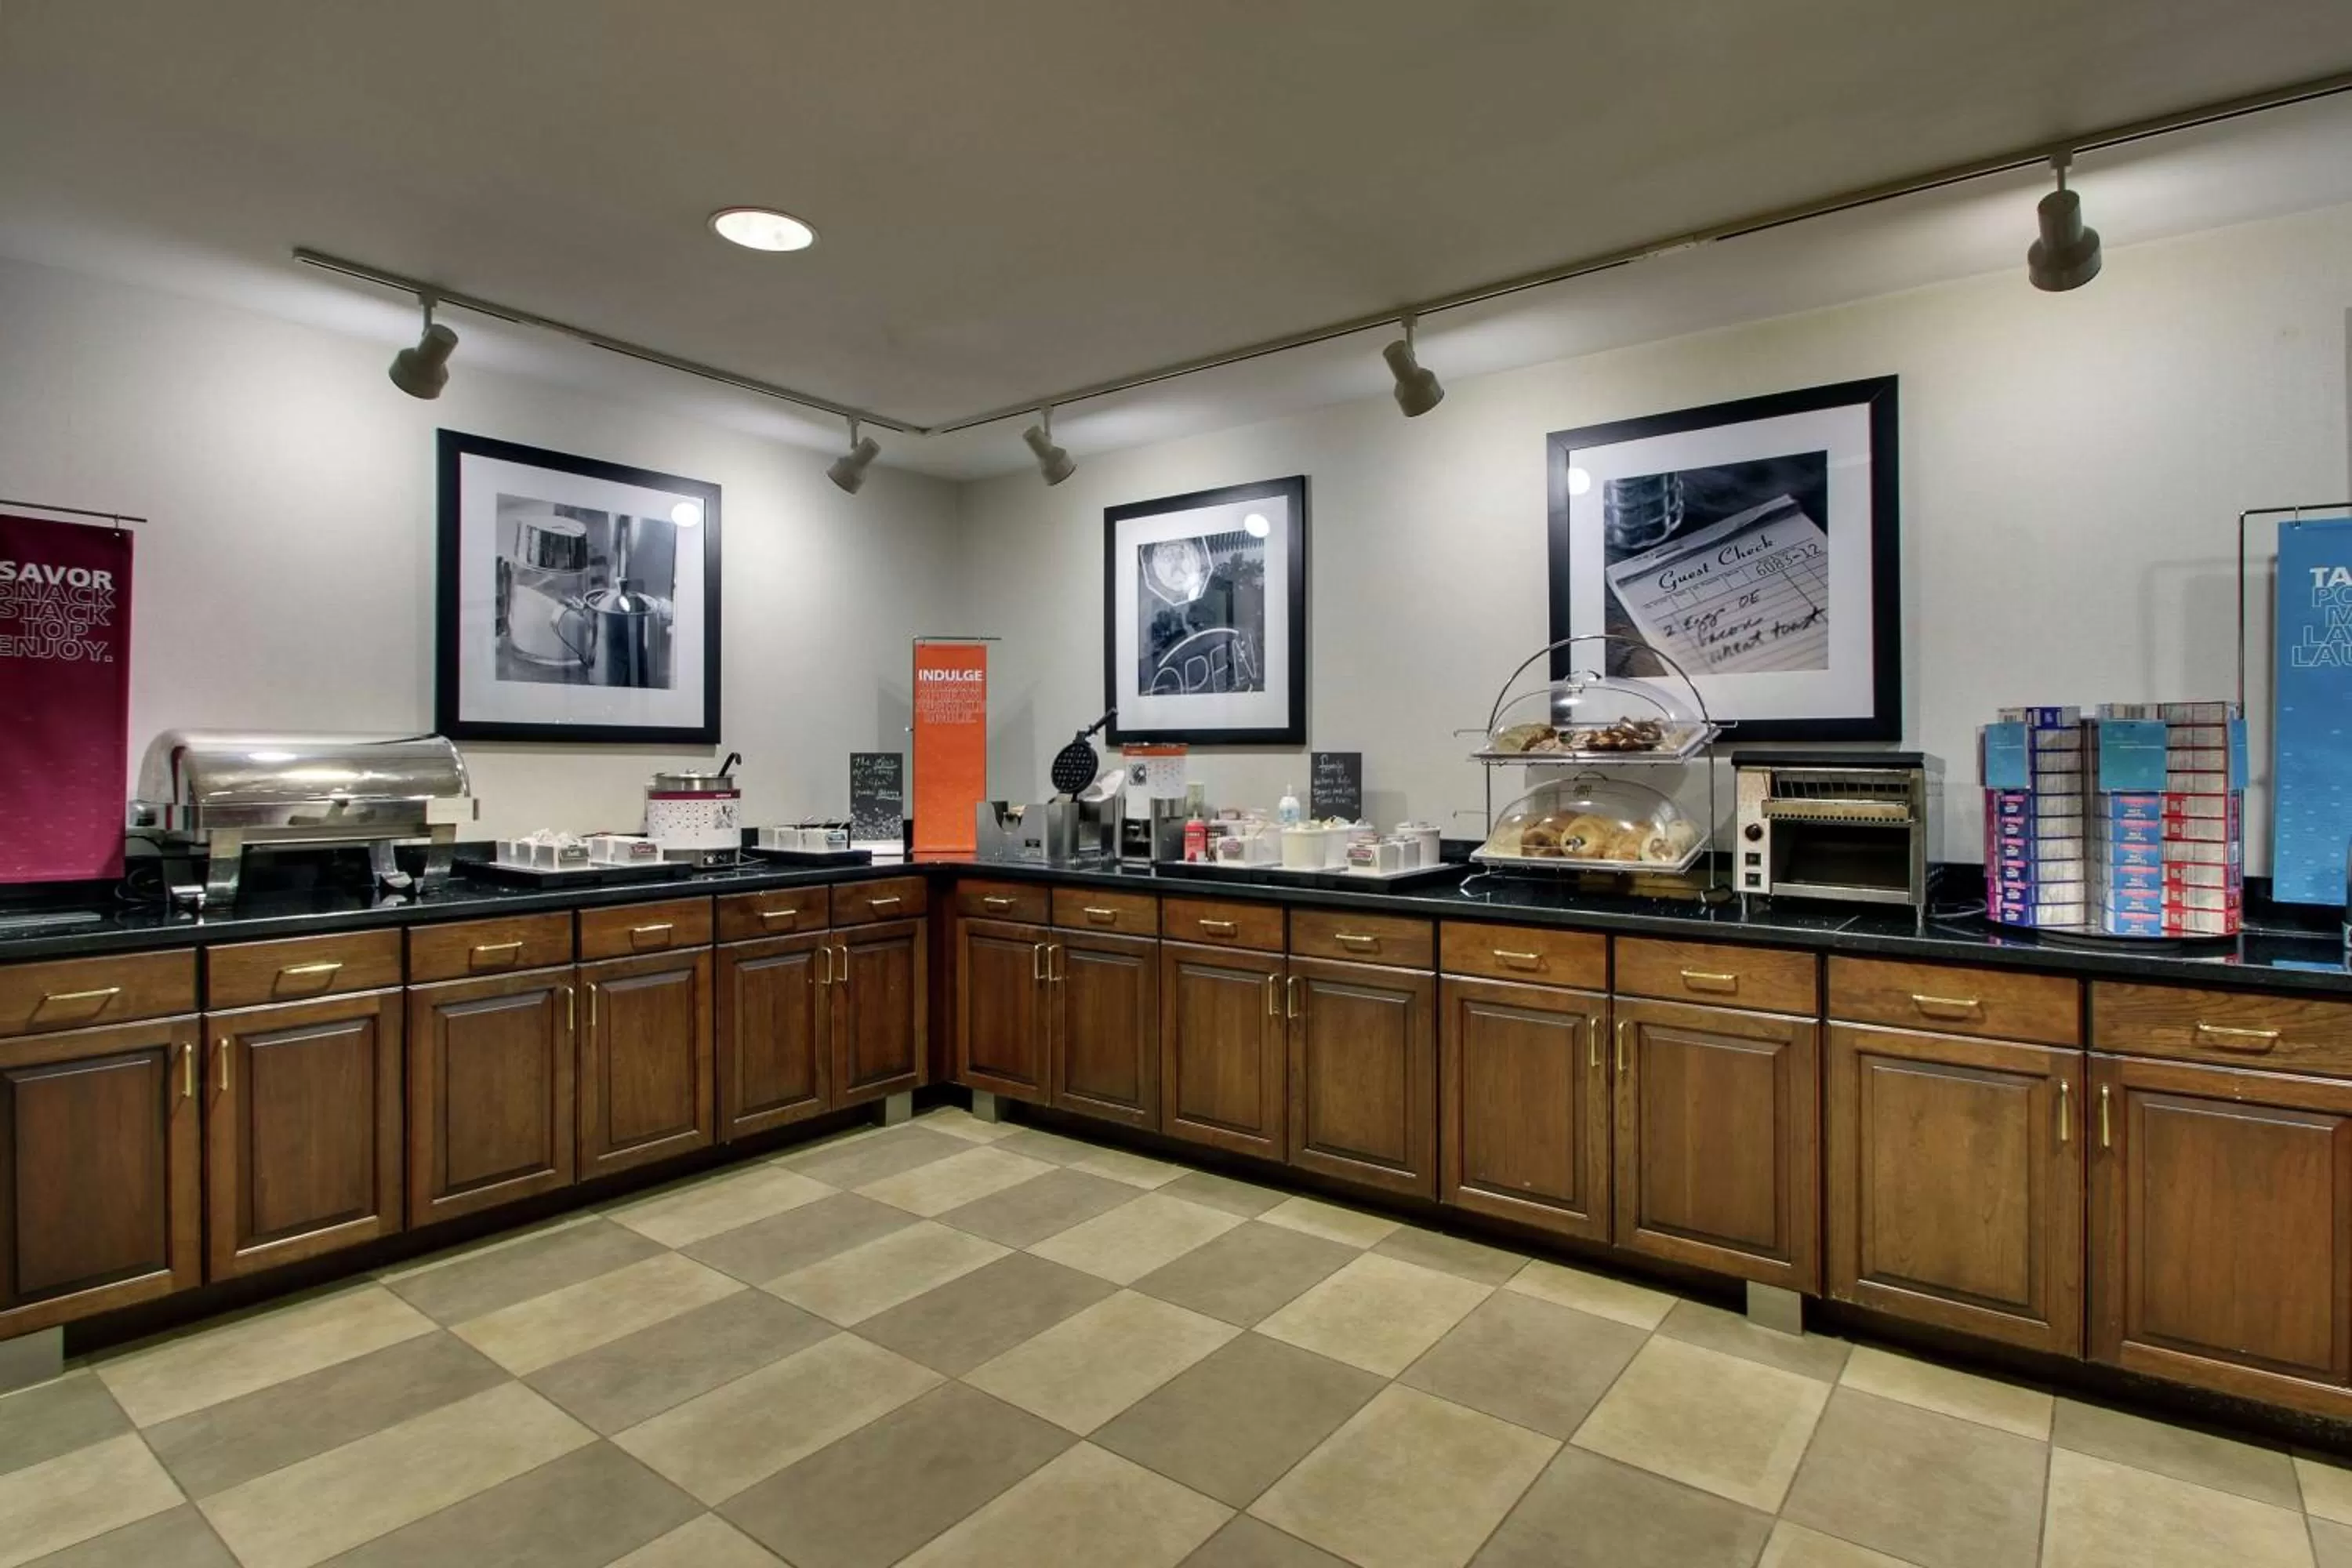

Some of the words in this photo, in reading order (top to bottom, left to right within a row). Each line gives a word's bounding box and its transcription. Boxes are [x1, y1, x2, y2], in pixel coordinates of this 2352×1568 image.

[0, 561, 112, 590] SAVOR
[1658, 562, 1709, 593] Guest
[1718, 535, 1774, 565] Check
[0, 580, 116, 608] SNACK
[0, 598, 111, 626] STACK
[19, 617, 89, 641] TOP
[918, 669, 983, 681] INDULGE
